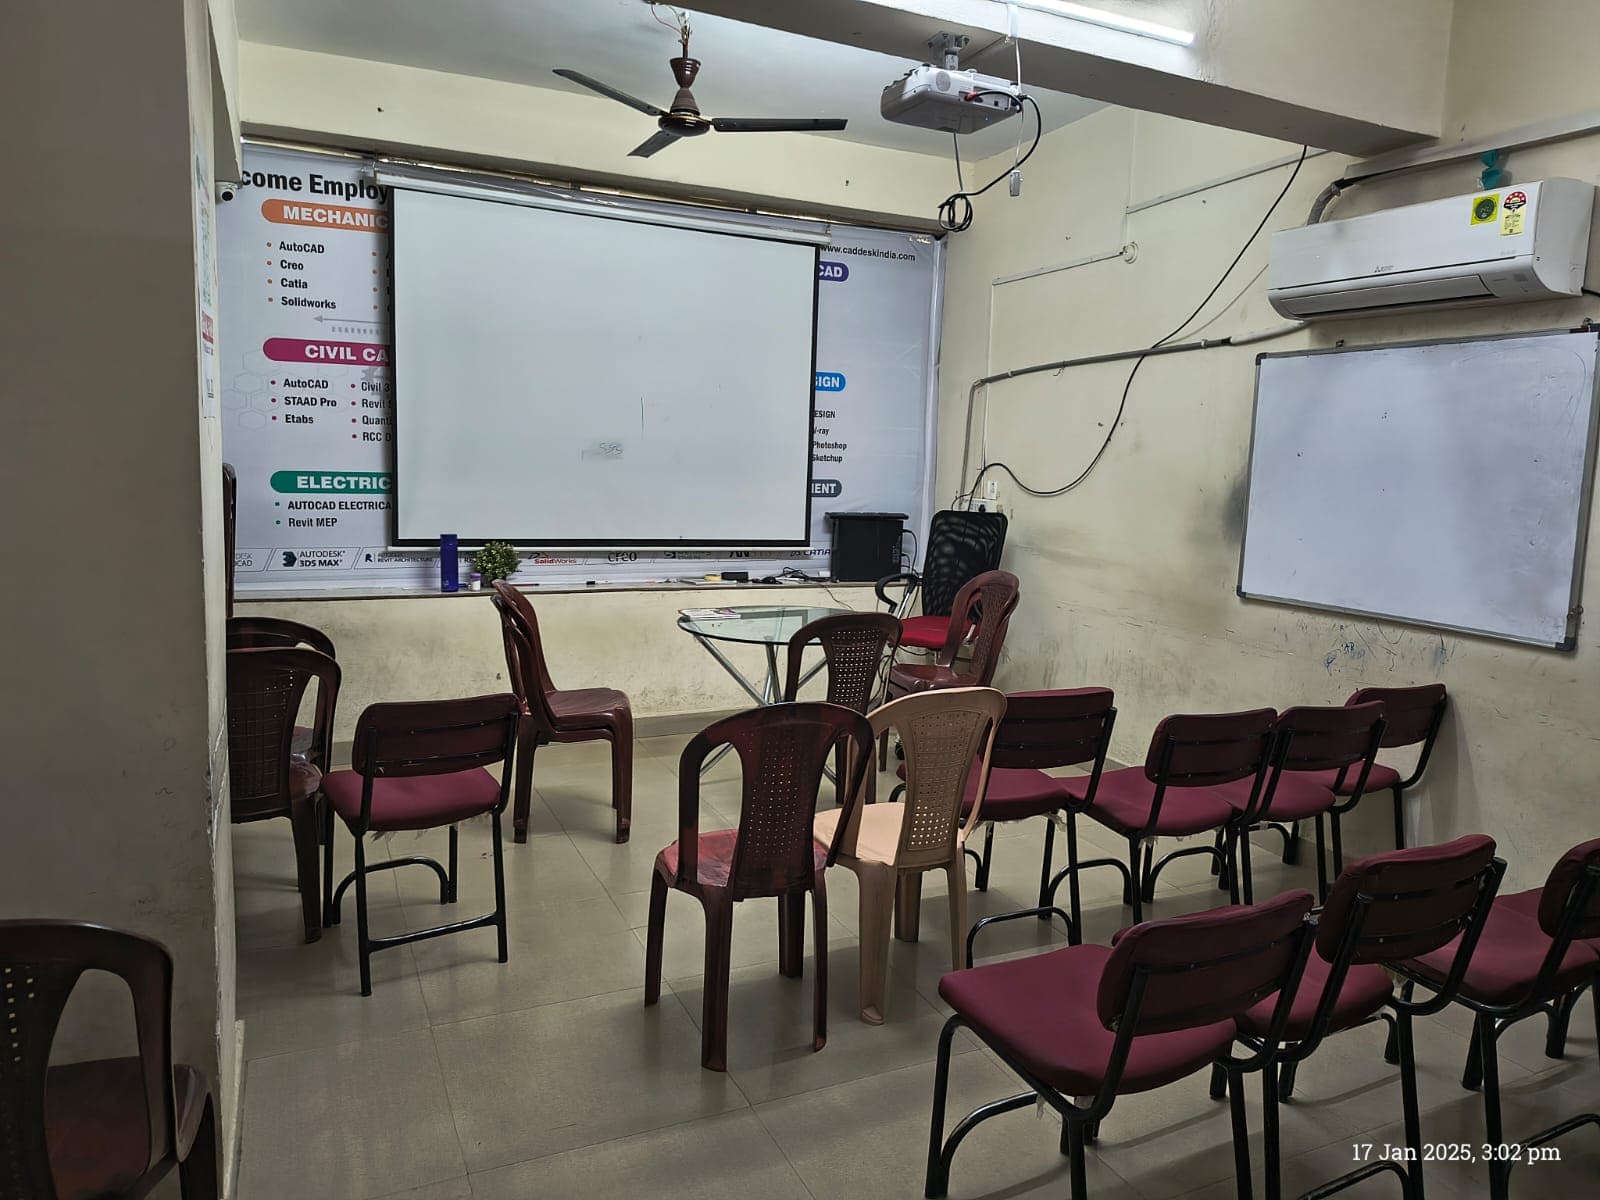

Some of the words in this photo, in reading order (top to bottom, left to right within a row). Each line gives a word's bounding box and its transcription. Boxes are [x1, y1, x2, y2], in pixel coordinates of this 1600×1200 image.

[283, 205, 388, 228] MECHANIC
[279, 241, 325, 254] AutoCAD
[280, 259, 304, 271] Creo
[280, 277, 308, 289] Catia
[281, 295, 337, 309] Solidworks
[305, 345, 357, 360] CIVIL
[362, 348, 388, 362] CA
[283, 378, 329, 390] AutoCAD
[361, 381, 381, 392] Civil
[284, 396, 318, 407] STAAD
[320, 397, 337, 407] Pro
[361, 398, 385, 409] Revit
[285, 413, 314, 424] Etabs
[362, 432, 382, 441] RCC
[296, 475, 392, 490] ELECTRIC
[288, 500, 336, 510] AUTOCAD
[338, 500, 392, 510] ELECTRICA
[288, 517, 314, 528] Revit
[316, 517, 338, 527] MEP
[299, 559, 316, 567] 3DS
